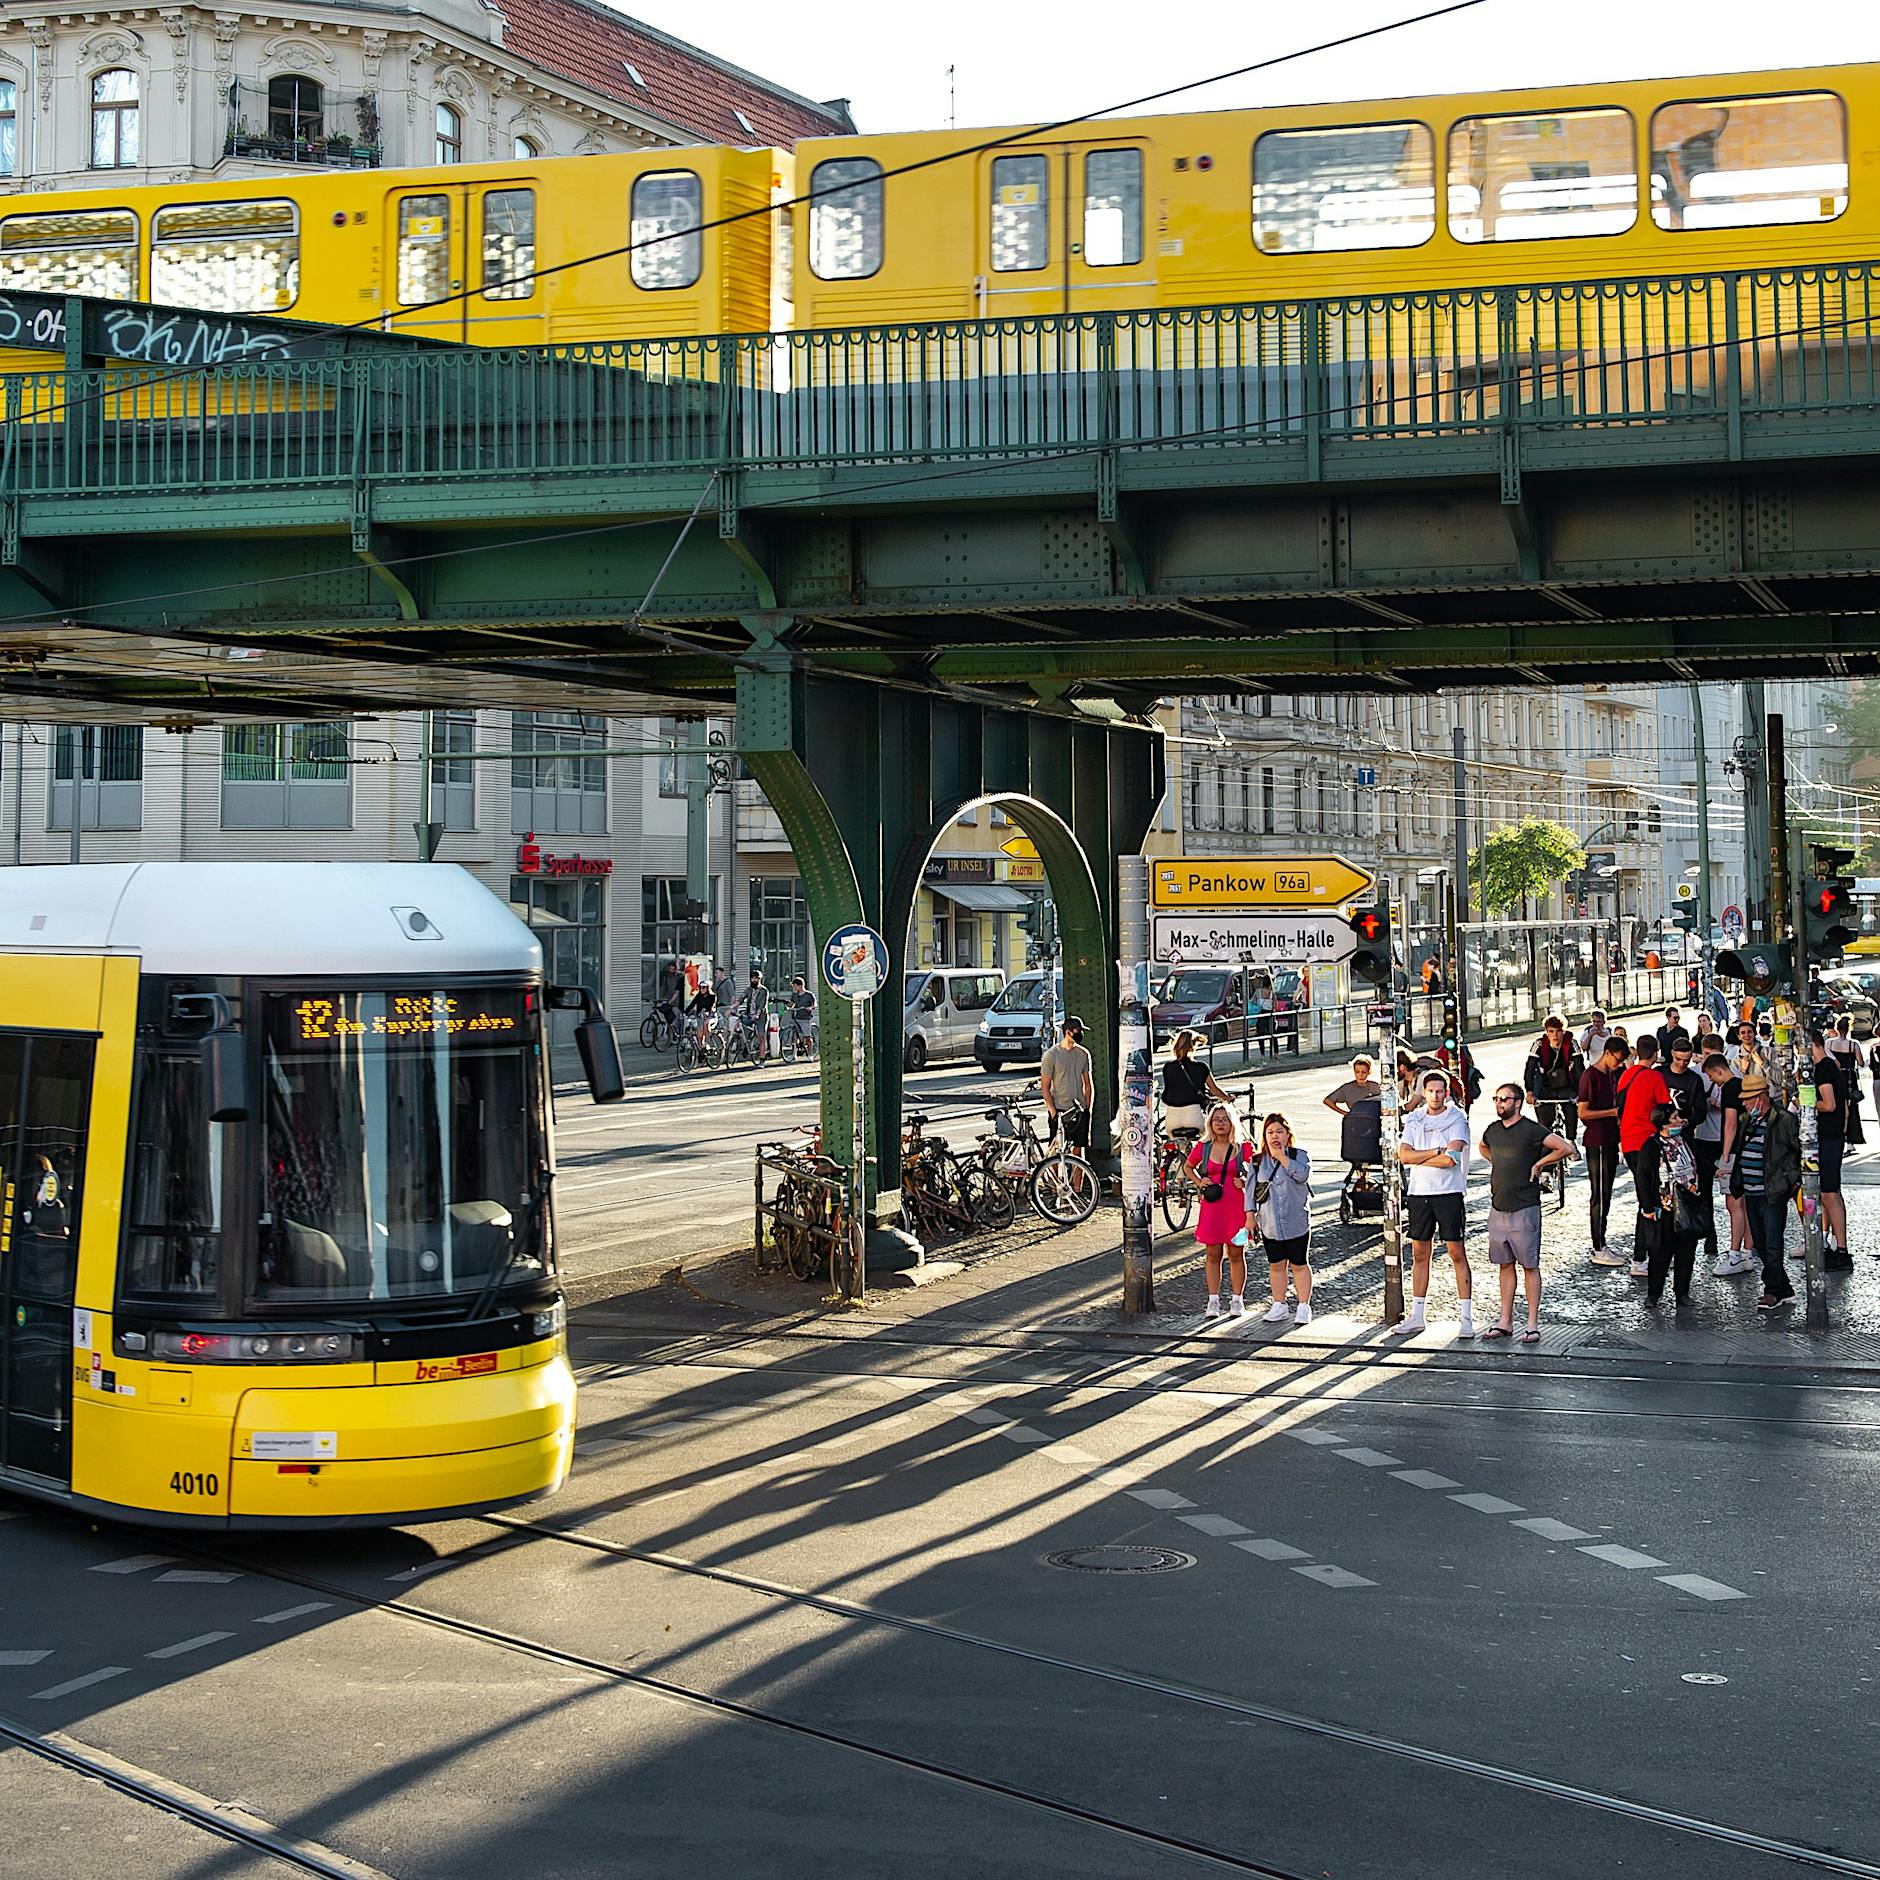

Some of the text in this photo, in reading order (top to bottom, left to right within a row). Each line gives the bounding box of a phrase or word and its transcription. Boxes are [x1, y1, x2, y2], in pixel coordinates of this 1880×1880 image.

[1361, 769, 1371, 784] T
[544, 853, 613, 878] Sparkasse
[925, 862, 944, 875] sky
[961, 859, 984, 872] INSEL
[1017, 865, 1033, 876] LOTTO
[1189, 874, 1305, 892] Pankow 96a
[1170, 930, 1335, 949] Max-Schmeling-Halle
[416, 1358, 495, 1380] be Berlin
[170, 1471, 218, 1496] 4010
